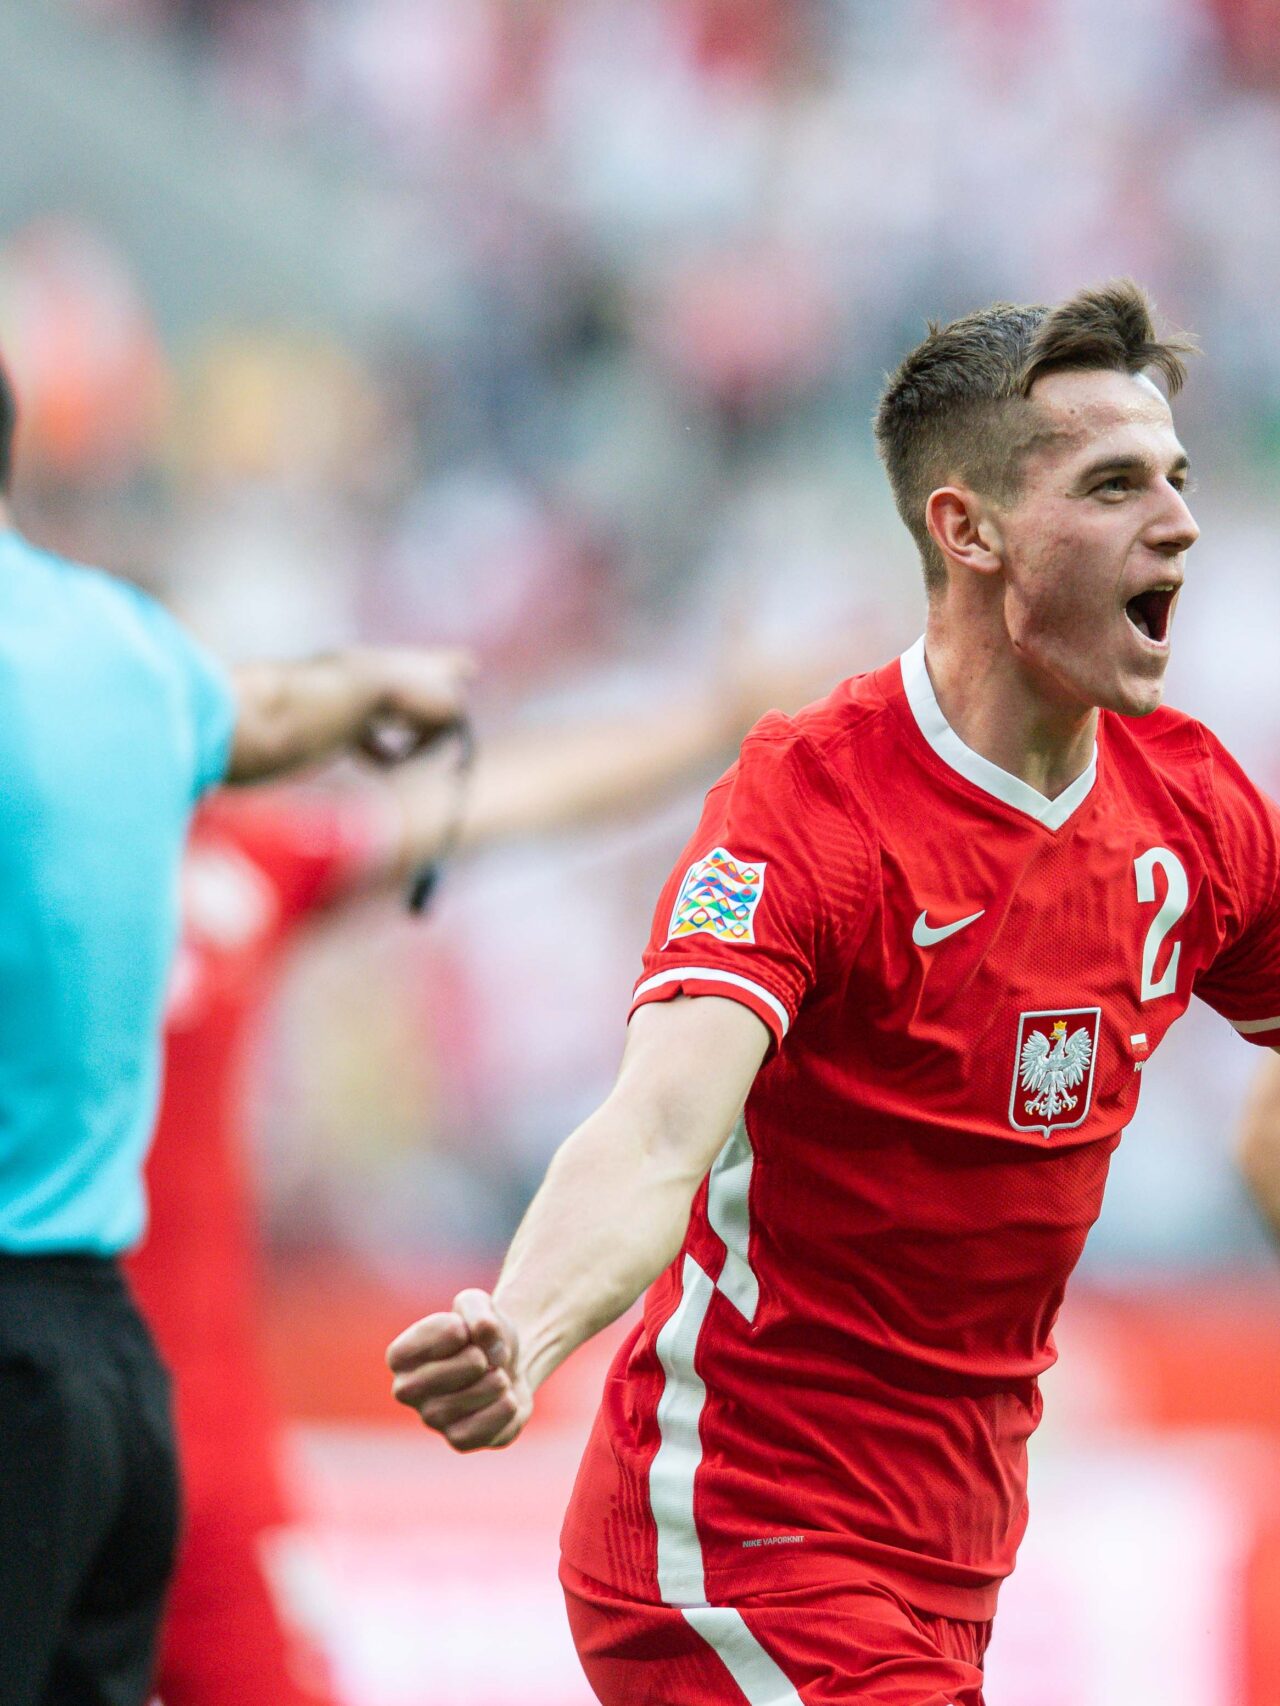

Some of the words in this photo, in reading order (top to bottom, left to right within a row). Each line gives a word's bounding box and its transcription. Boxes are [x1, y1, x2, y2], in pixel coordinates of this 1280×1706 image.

[1133, 846, 1189, 1003] 2
[742, 1539, 762, 1548] NIKE
[763, 1535, 805, 1546] VAPORKNIT
